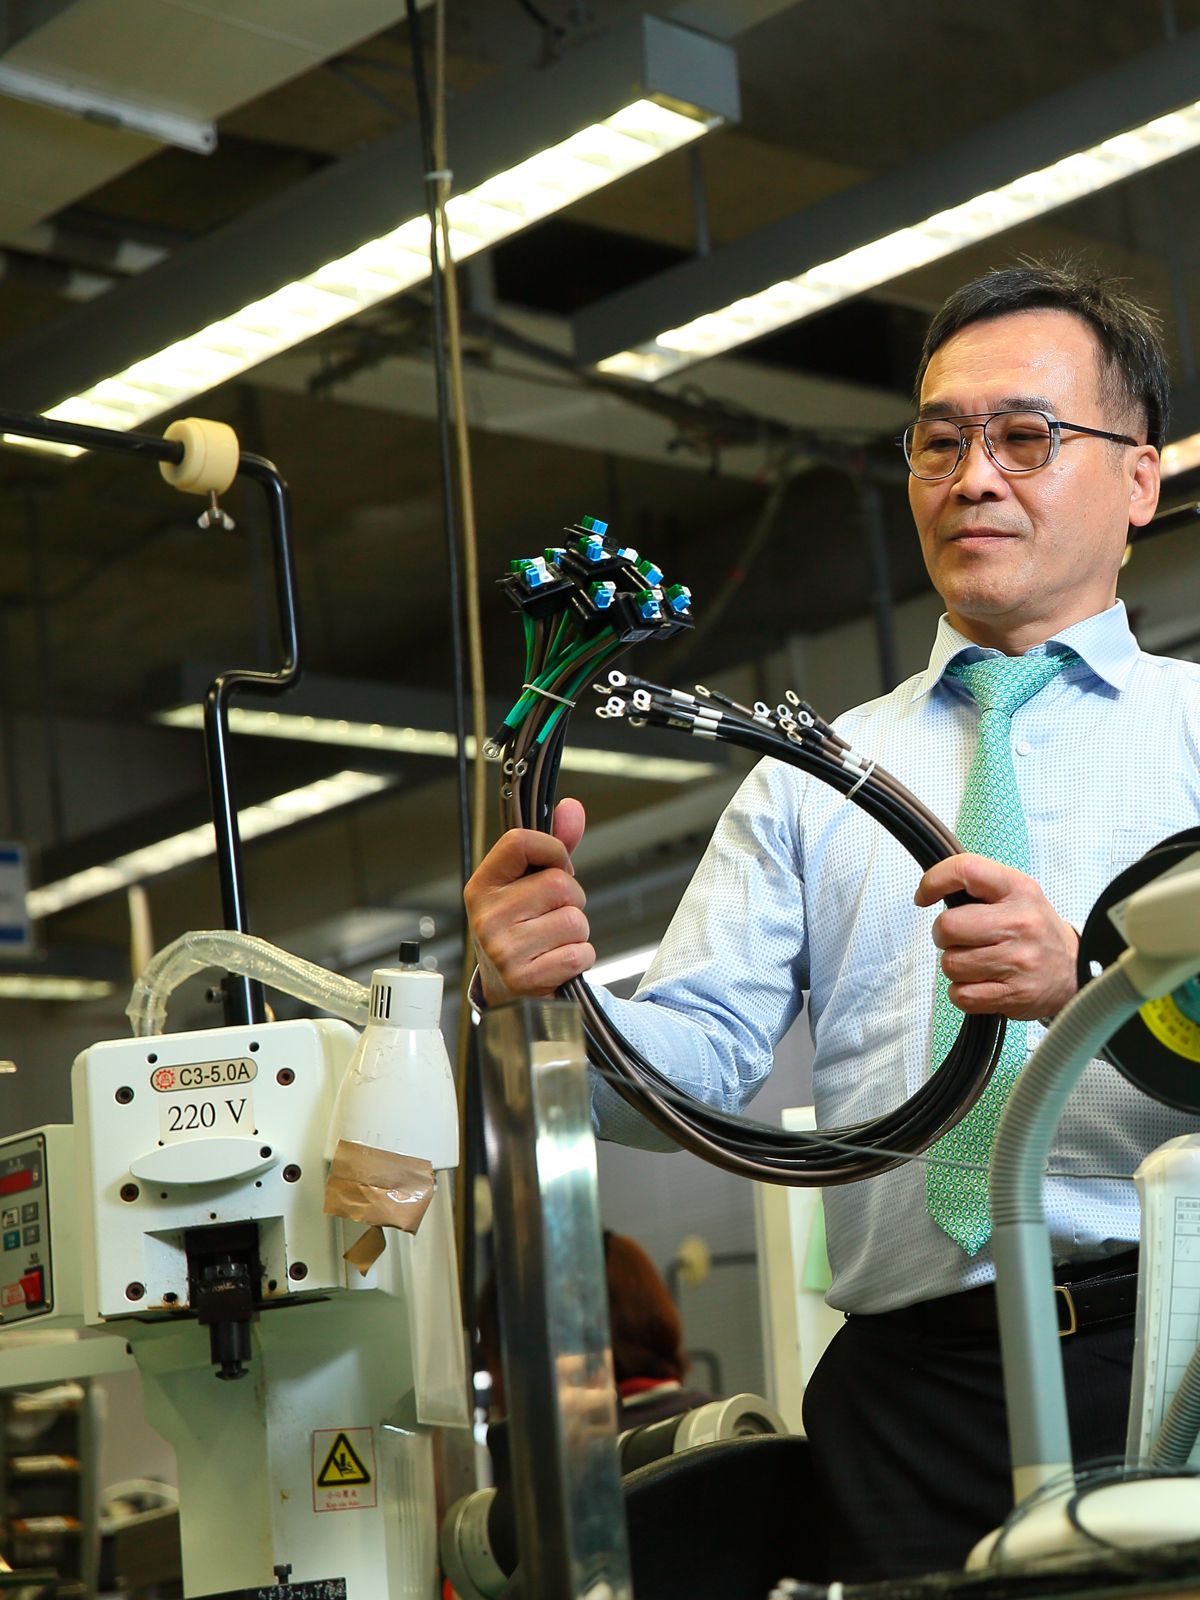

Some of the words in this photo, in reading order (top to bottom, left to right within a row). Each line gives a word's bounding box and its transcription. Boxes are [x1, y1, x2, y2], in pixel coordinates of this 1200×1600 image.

[179, 1062, 251, 1086] C3-5.0A
[167, 1101, 216, 1132] 220
[224, 1098, 248, 1124] V
